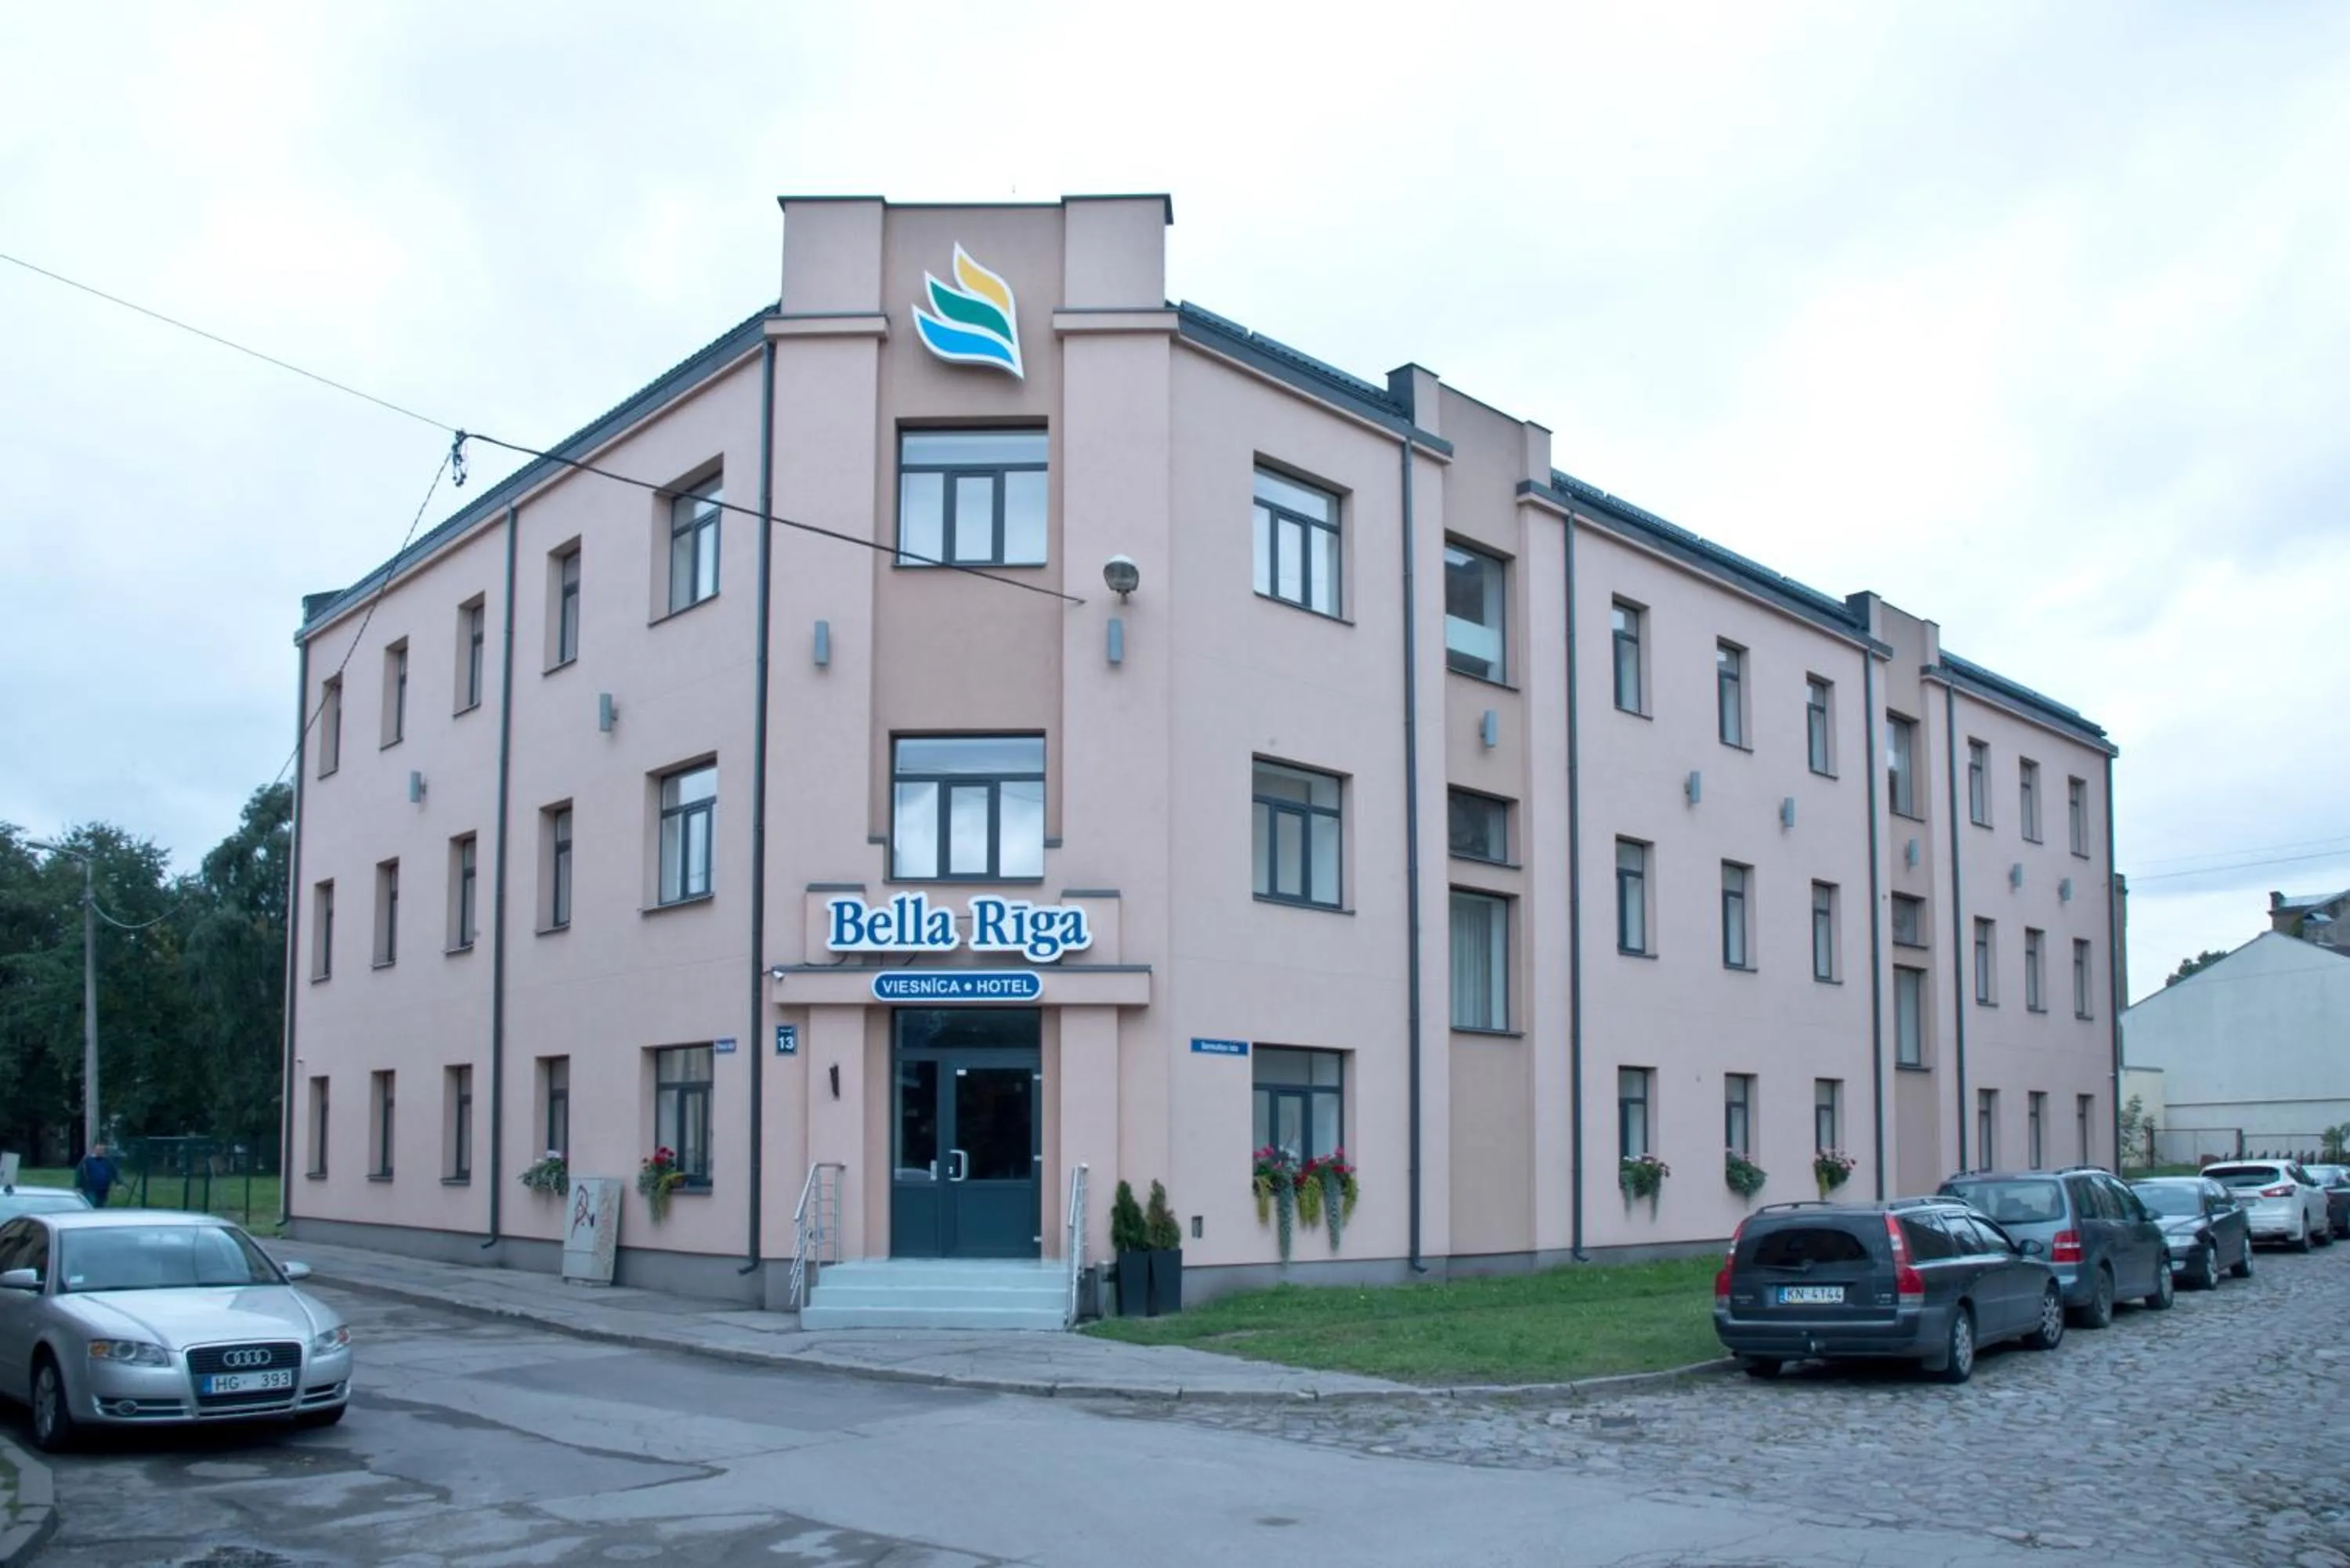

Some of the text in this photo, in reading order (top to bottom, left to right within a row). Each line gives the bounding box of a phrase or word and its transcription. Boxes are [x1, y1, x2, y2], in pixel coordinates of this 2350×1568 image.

[830, 896, 1088, 957] Bella Rīga
[881, 977, 1033, 994] VIESNĪCA HOTEL
[778, 1035, 794, 1050] 13
